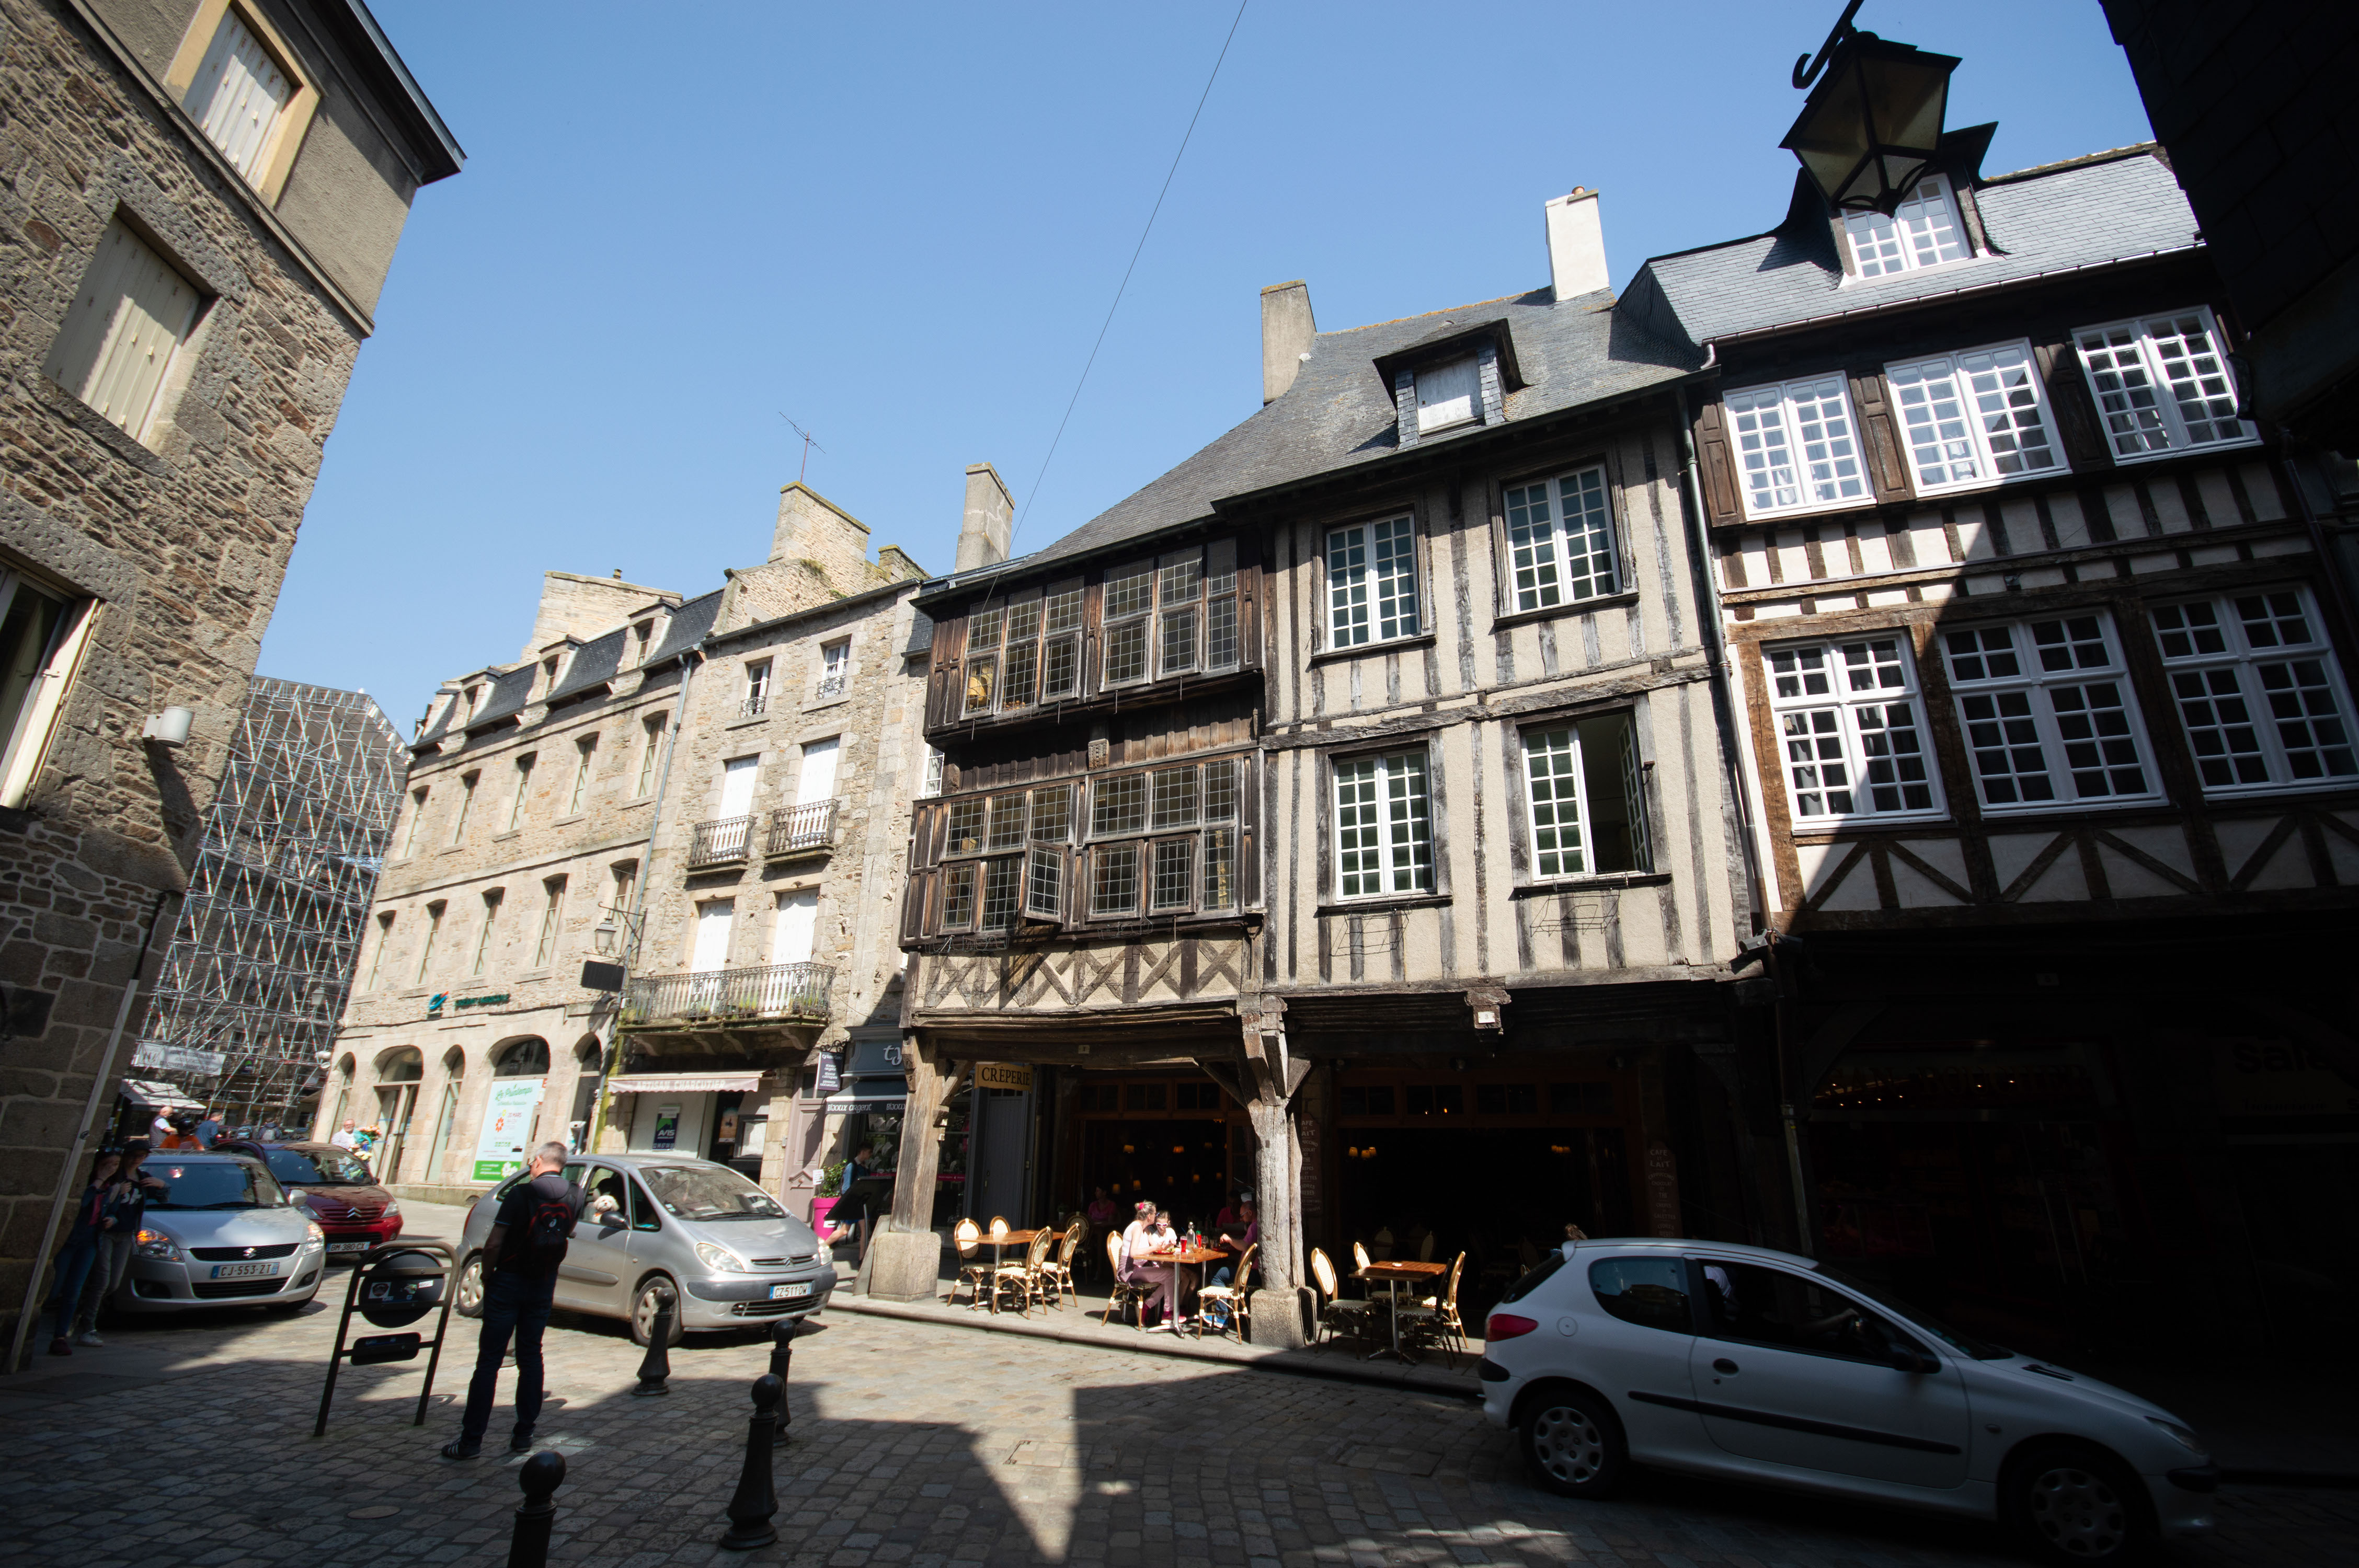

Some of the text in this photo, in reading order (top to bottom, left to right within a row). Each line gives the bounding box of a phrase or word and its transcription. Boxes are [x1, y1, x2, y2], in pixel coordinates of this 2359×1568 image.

[981, 1066, 1030, 1086] CRÊPERIE
[636, 1080, 725, 1090] ARTISAN CHARCUTIER
[330, 1242, 365, 1251] BM-380-CX
[221, 1264, 272, 1276] CJ-553-ZT
[775, 1285, 808, 1297] CZ-511-DW
